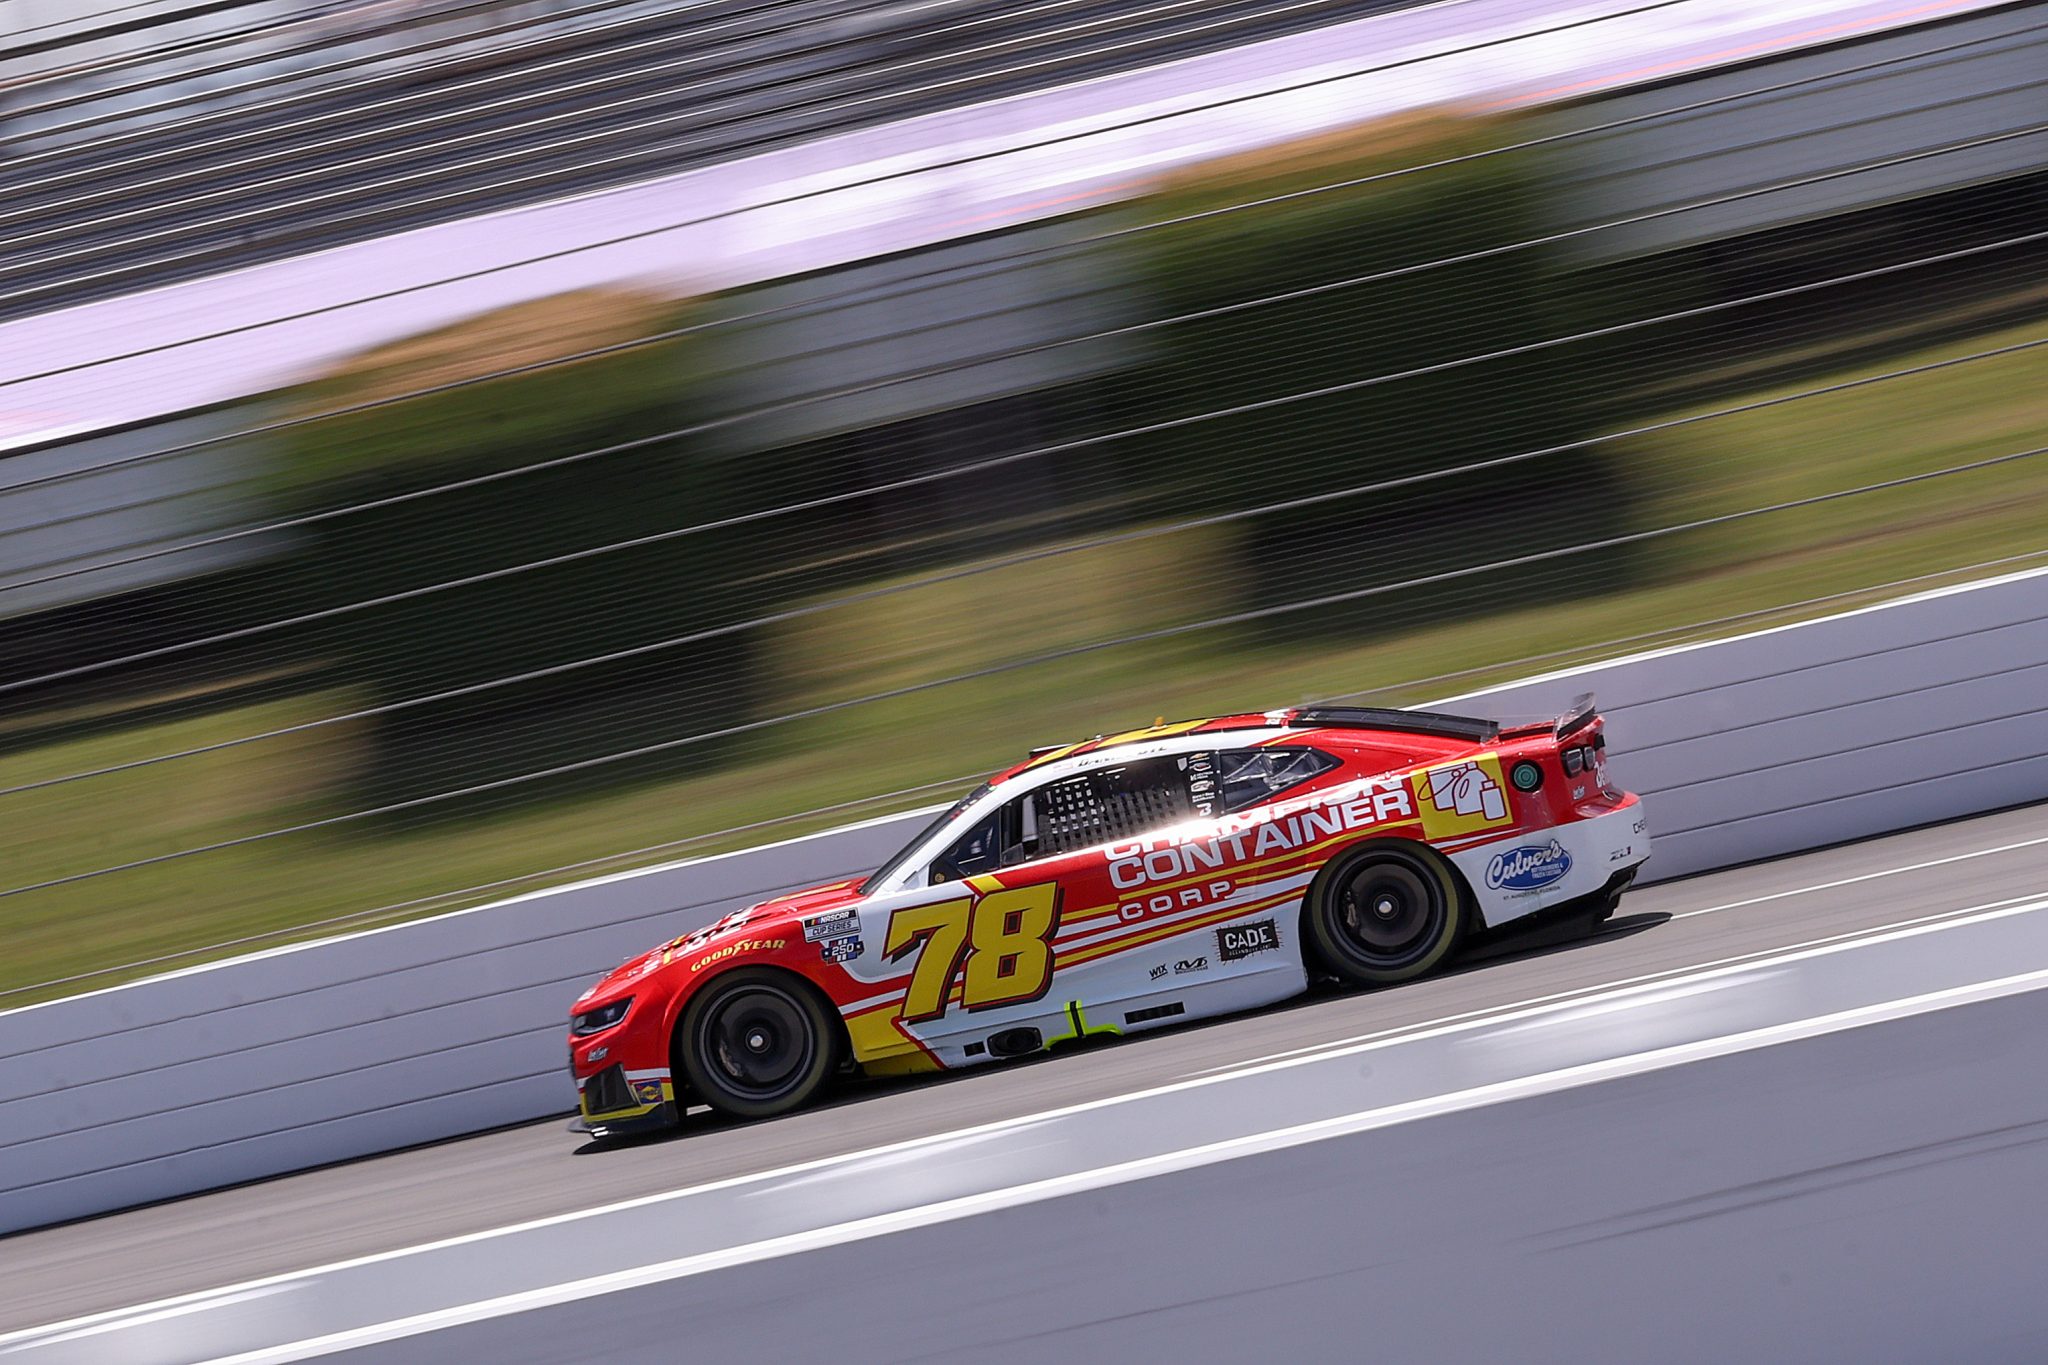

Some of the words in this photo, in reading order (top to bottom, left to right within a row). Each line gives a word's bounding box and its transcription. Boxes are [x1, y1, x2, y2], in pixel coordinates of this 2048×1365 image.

[1108, 788, 1412, 889] CONTAINER
[1486, 839, 1562, 890] Culver's
[1120, 880, 1231, 920] CORP
[812, 924, 828, 936] CUP
[827, 920, 852, 933] SERIES
[819, 910, 850, 924] NASCAR
[831, 942, 855, 957] 250
[1224, 926, 1273, 950] CADE
[690, 938, 786, 973] GOODYEAR
[881, 880, 1065, 1026] 78
[1149, 963, 1168, 979] WIX
